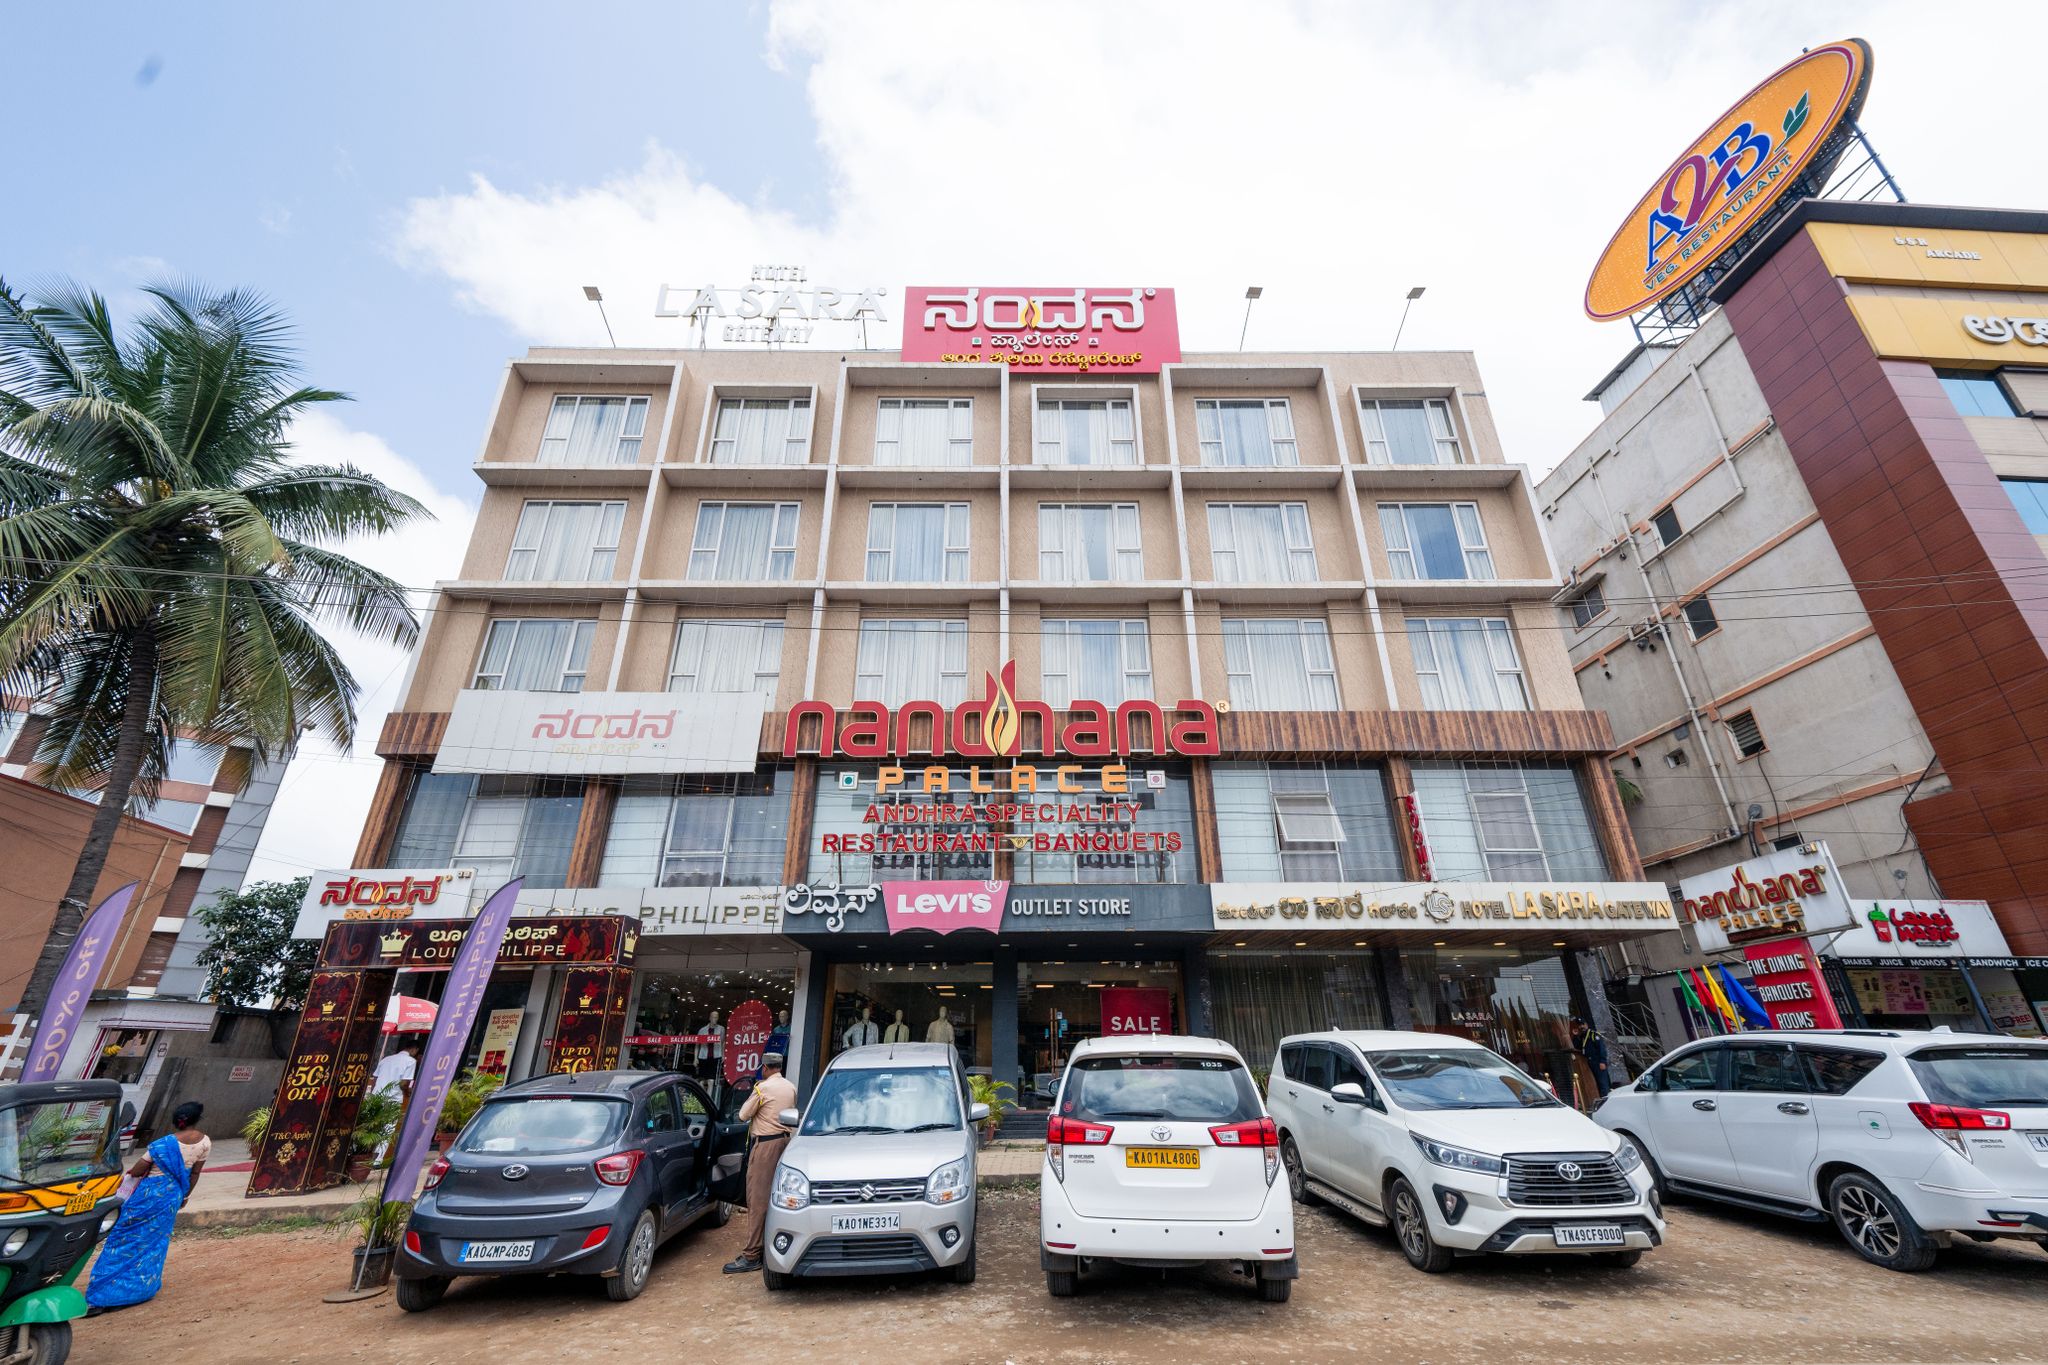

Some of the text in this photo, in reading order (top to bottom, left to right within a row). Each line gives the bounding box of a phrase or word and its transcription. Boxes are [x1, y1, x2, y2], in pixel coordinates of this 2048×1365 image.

[1681, 153, 1792, 261] RESTAURANT
[655, 283, 888, 322] LA SARA
[923, 287, 1146, 332] ನಂದನ
[876, 764, 1129, 795] PALACE
[862, 802, 1143, 824] ANDHRA SPECIALITY
[821, 831, 1183, 854] RESTAURANT BANQUETS
[638, 904, 781, 925] PHILIPPE
[1010, 898, 1132, 917] OUTLET STORE
[1460, 900, 1511, 920] HOTEL
[1508, 891, 1542, 919] LA
[1540, 890, 1604, 920] SARA
[1718, 902, 1805, 933] PALACE
[412, 944, 567, 959] LOUI HILIPPE
[1746, 958, 1769, 976] FINE
[1767, 953, 1807, 973] DINING
[1842, 958, 1873, 966] SHAKES
[1879, 958, 1904, 966] JUICE
[1910, 959, 1948, 967] MOMOS
[1969, 958, 2019, 967] SANDWICH
[444, 911, 496, 1039] PHILIPPE
[1758, 982, 1812, 1002] BANQUETS
[34, 936, 100, 1073] 50% off
[1111, 1016, 1162, 1032] SALE
[1775, 1011, 1815, 1030] ROOMS
[624, 1036, 639, 1044] SALE
[647, 1036, 662, 1044] SALE
[734, 1032, 765, 1046] SALE
[297, 1053, 330, 1065] UP TO
[561, 1046, 591, 1056] UP TO
[287, 1085, 320, 1102] OFF
[337, 1084, 361, 1099] OFF
[1133, 1151, 1199, 1166] KA01AL4806
[1561, 1228, 1622, 1242] TN49CF9000
[466, 1244, 532, 1259] KA04MP4885
